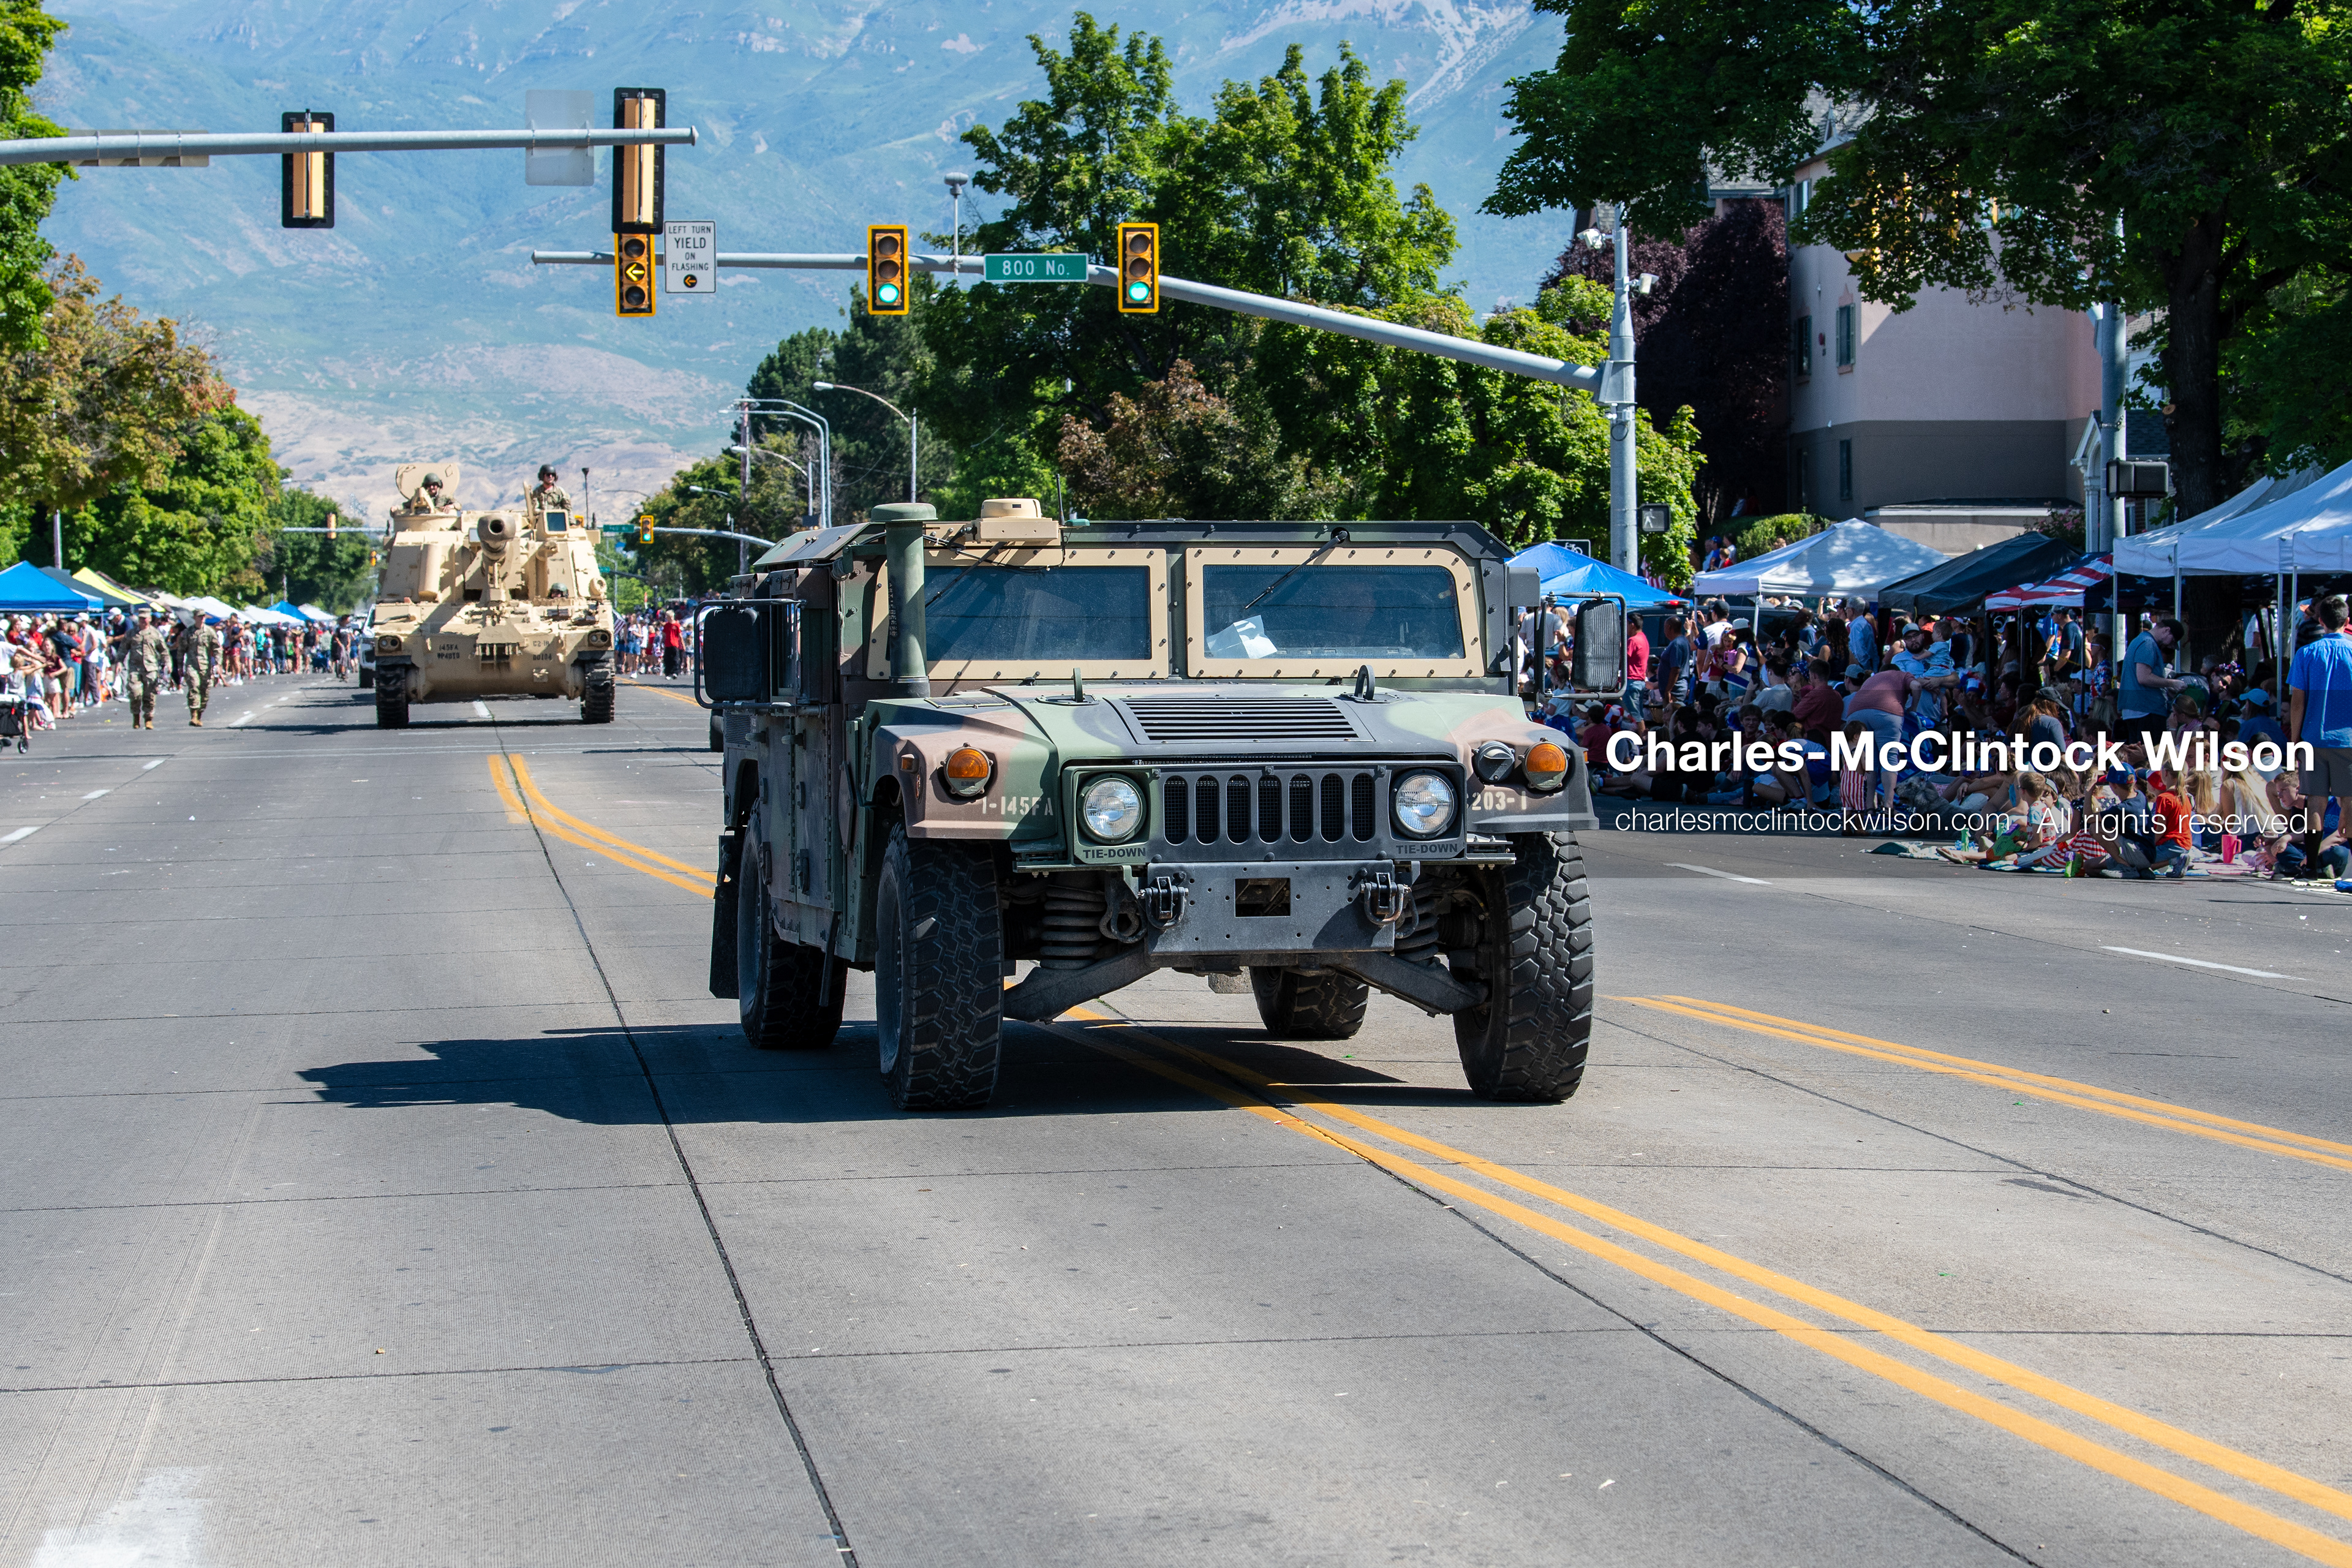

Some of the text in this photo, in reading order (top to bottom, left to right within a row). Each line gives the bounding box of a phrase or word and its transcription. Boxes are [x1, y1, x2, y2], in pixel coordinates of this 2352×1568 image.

[674, 238, 706, 248] YIELD
[1002, 260, 1071, 276] 800 No.
[982, 796, 1054, 816] 1-145FA
[1466, 791, 1527, 811] 203-1
[1082, 847, 1147, 859] TIE-DOWN
[1395, 843, 1458, 854] TIE-DOWN
